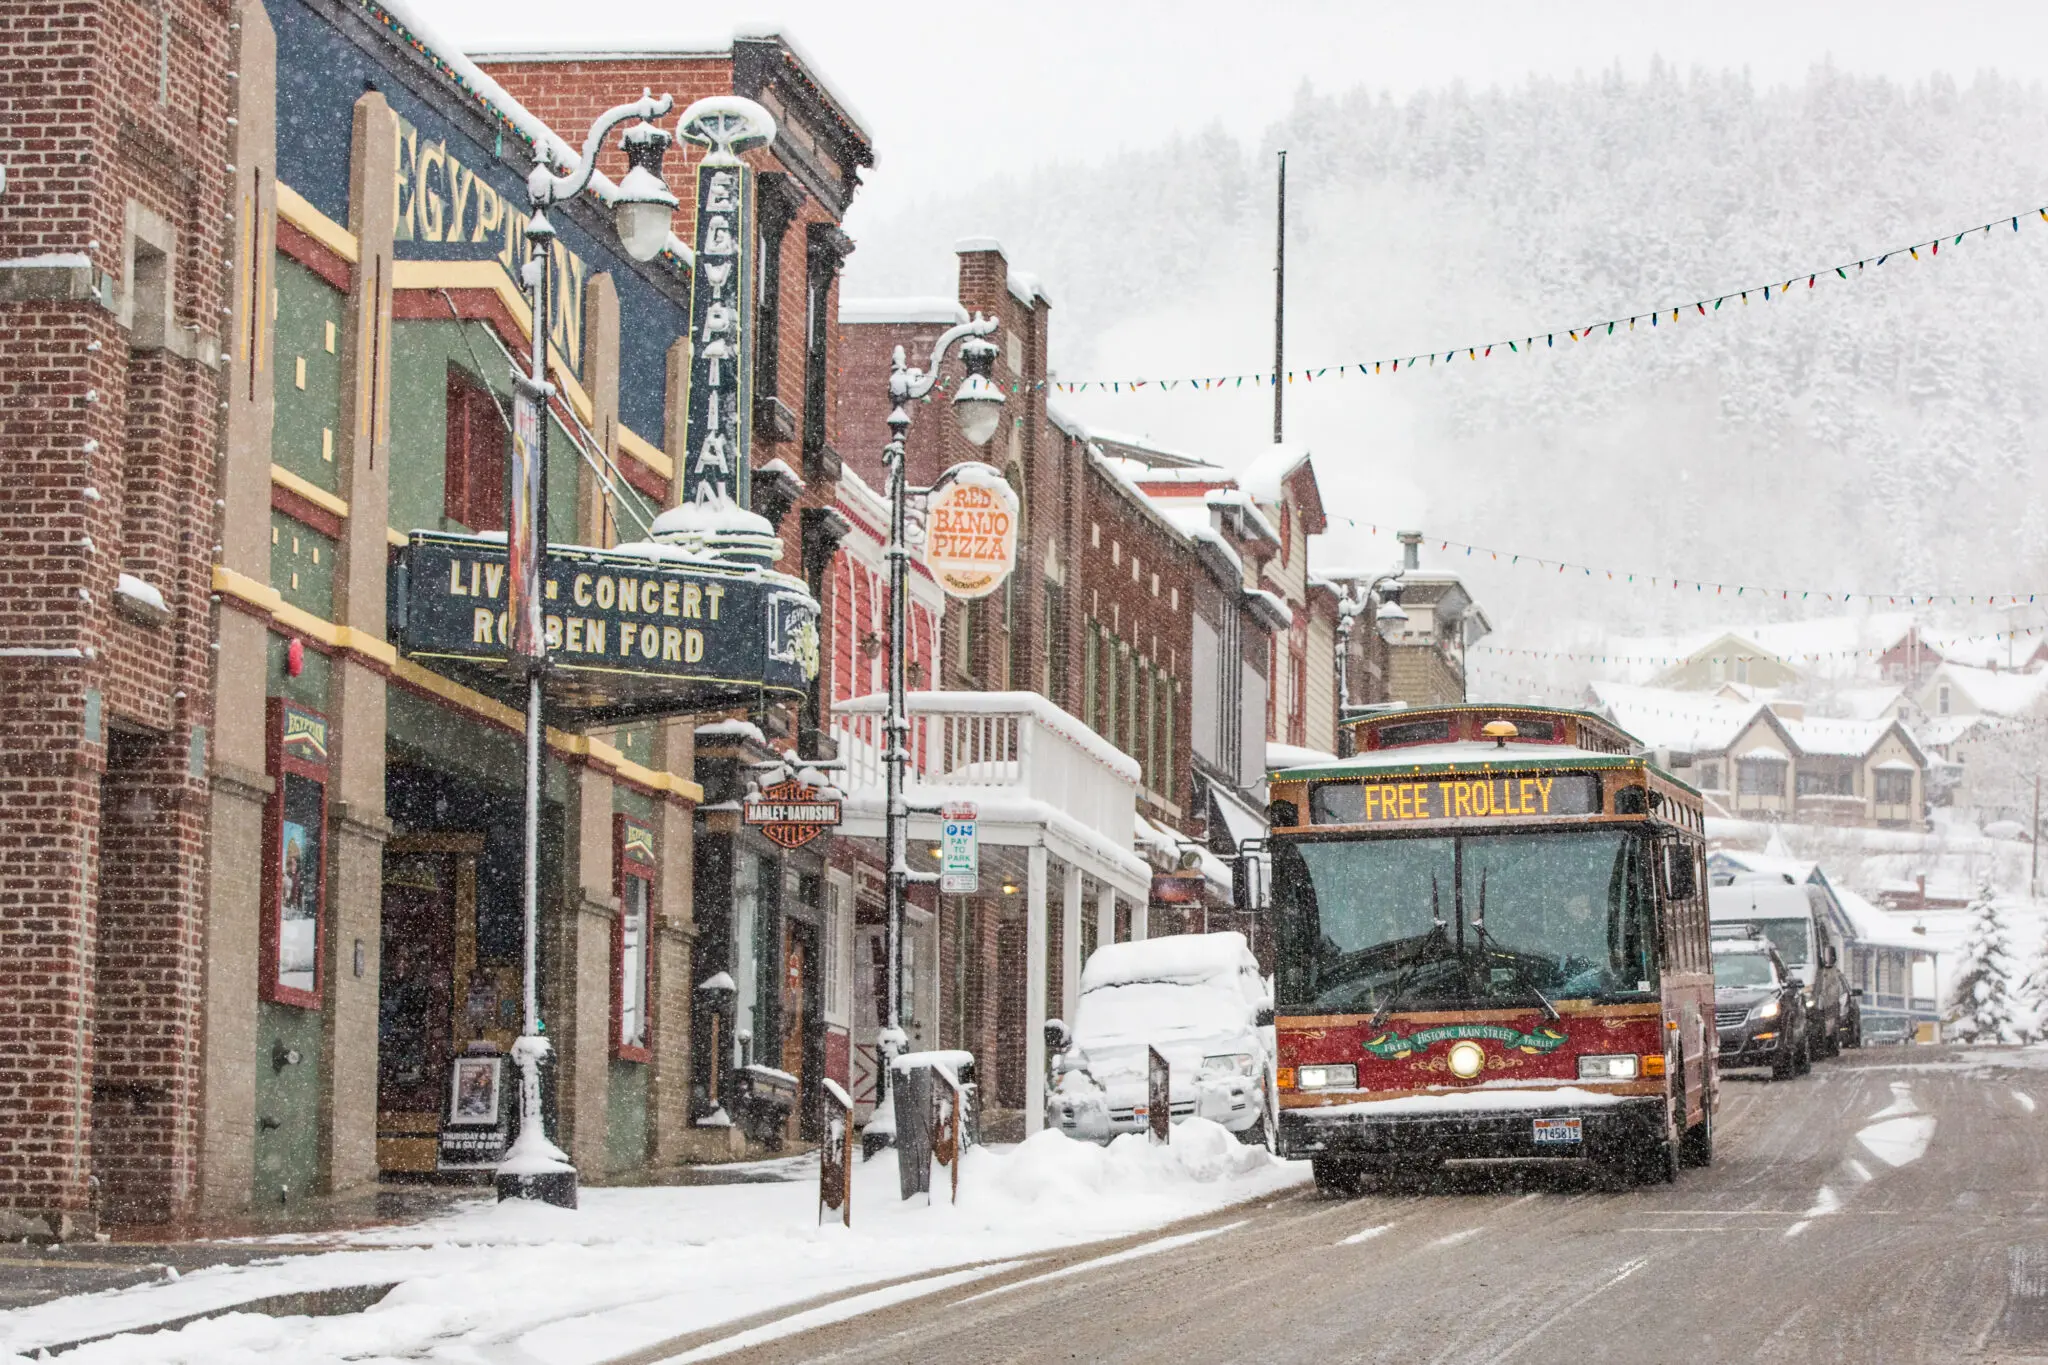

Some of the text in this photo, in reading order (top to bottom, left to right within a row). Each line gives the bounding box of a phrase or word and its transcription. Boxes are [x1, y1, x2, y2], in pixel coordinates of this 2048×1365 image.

[393, 112, 588, 376] EGYPTIN
[694, 171, 733, 510] EGYPTIAN
[953, 487, 992, 509] RED
[934, 508, 1009, 536] BANJO
[932, 533, 1006, 560] PIZZA
[450, 559, 504, 599] LIV
[573, 573, 725, 621] CONCERT
[473, 607, 704, 663] ROBEN FORD
[1365, 778, 1553, 820] FREE TROLLEY
[748, 805, 836, 821] HARLEY-DAVIDSON
[769, 825, 815, 845] CYCLES
[953, 846, 966, 854] TO
[1458, 1026, 1483, 1038] MAIN
[1483, 1026, 1514, 1041] STREET
[443, 1132, 478, 1140] THURSDAY
[443, 1141, 455, 1149] FRI
